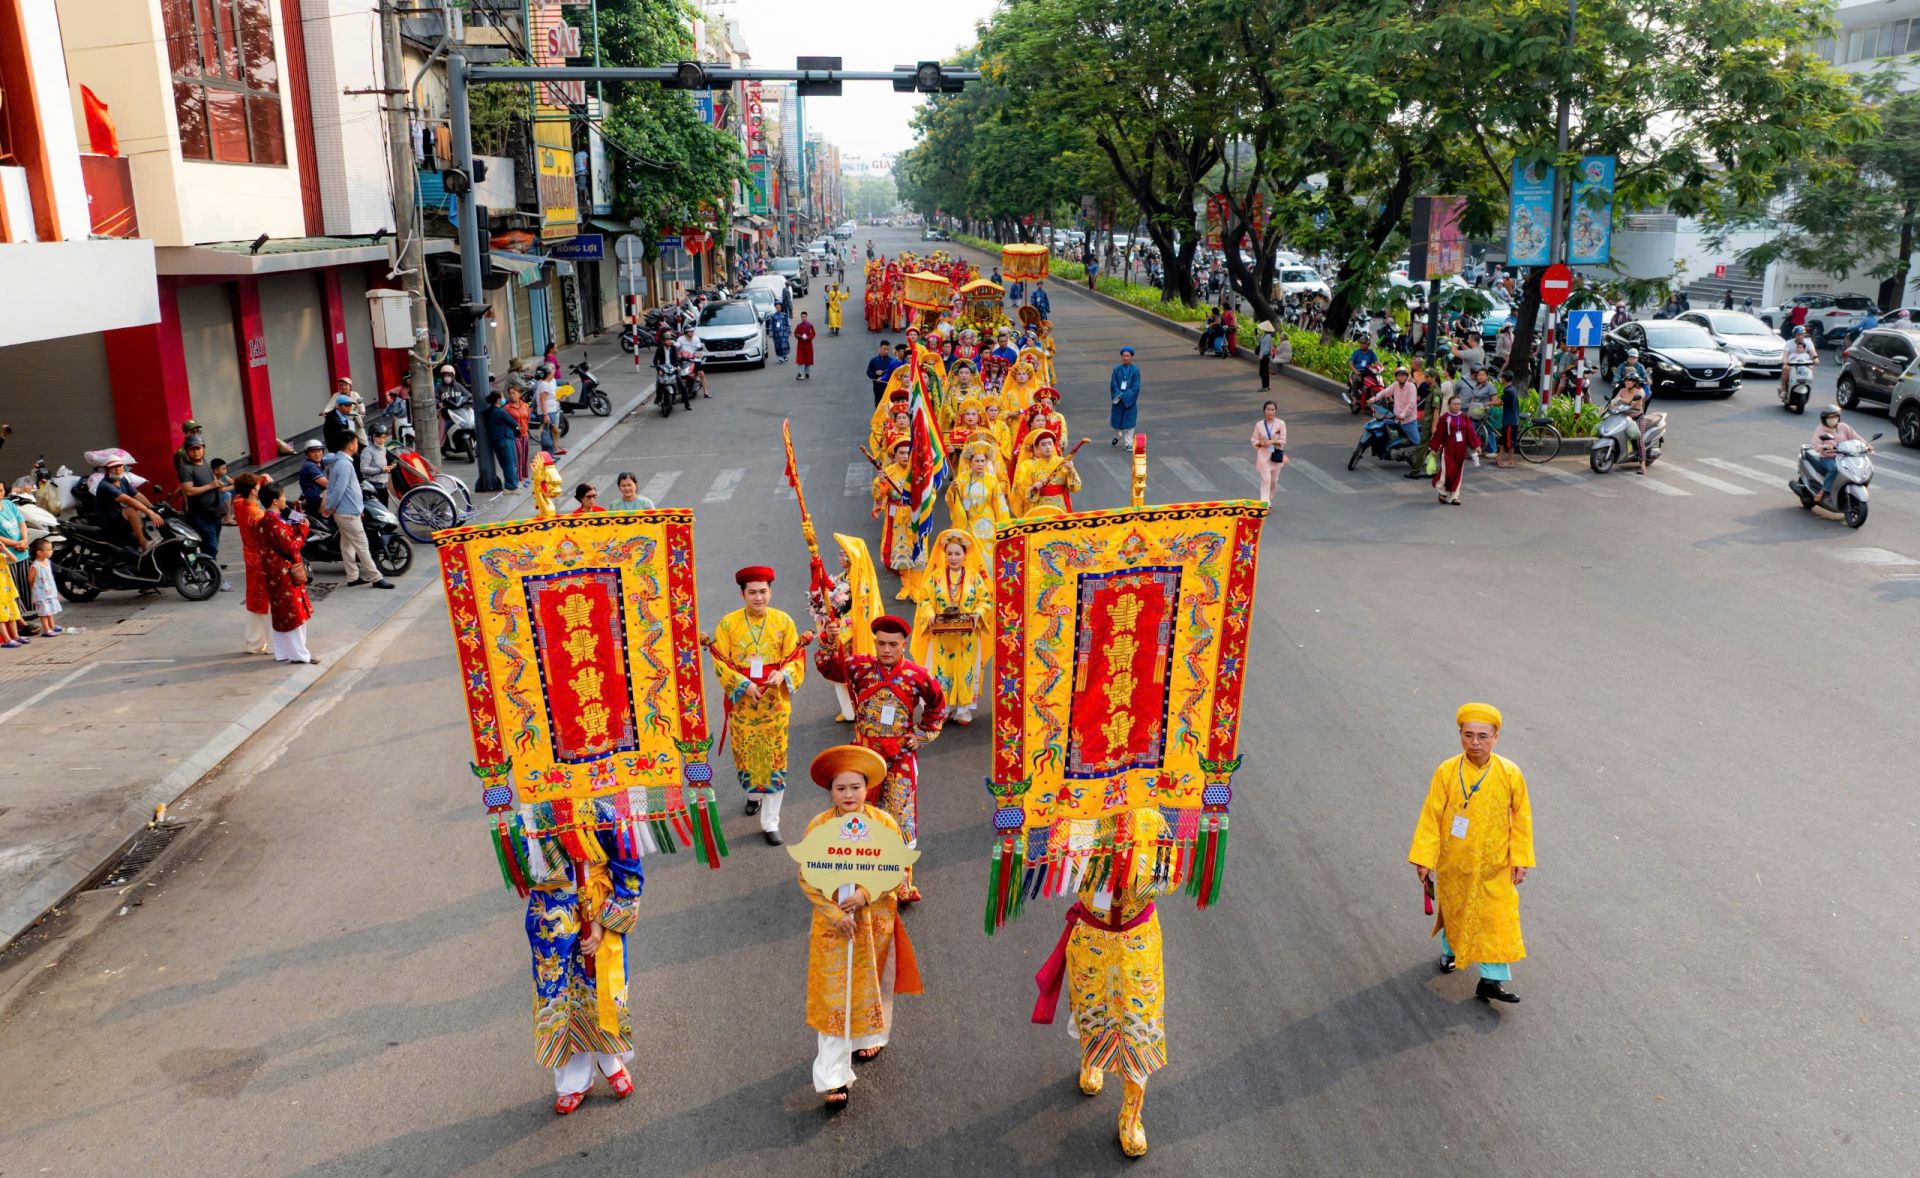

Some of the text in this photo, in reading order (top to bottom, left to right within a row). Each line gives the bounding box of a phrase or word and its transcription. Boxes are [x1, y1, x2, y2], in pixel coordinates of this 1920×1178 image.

[827, 847, 852, 857] ĐẠO
[806, 860, 833, 870] THÁNH
[877, 864, 900, 872] CUNG
